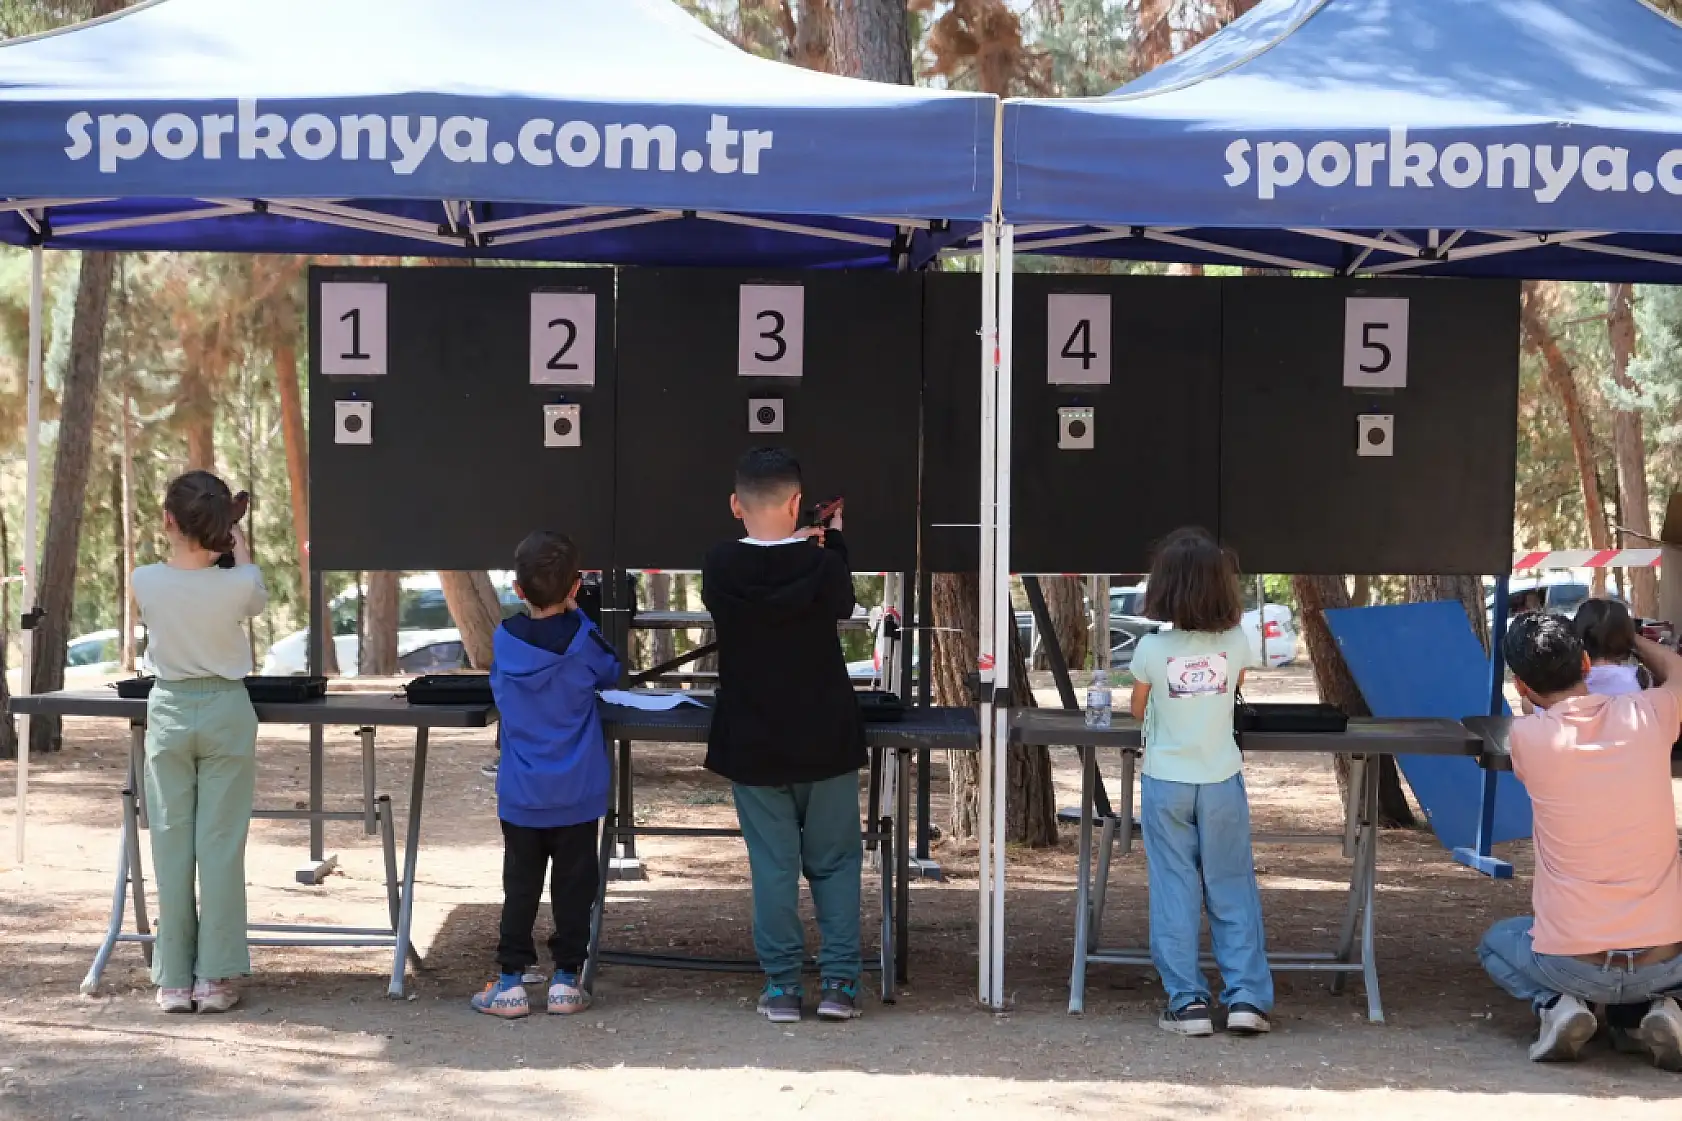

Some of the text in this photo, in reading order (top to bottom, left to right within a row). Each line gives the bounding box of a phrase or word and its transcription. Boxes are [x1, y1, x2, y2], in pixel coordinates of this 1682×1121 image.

[64, 97, 774, 175] sporkonya.com.tr
[340, 309, 371, 360] 1
[546, 318, 579, 370] 2
[754, 309, 787, 362] 3
[1060, 320, 1098, 370] 4
[1359, 322, 1392, 374] 5
[1191, 671, 1205, 683] 27
